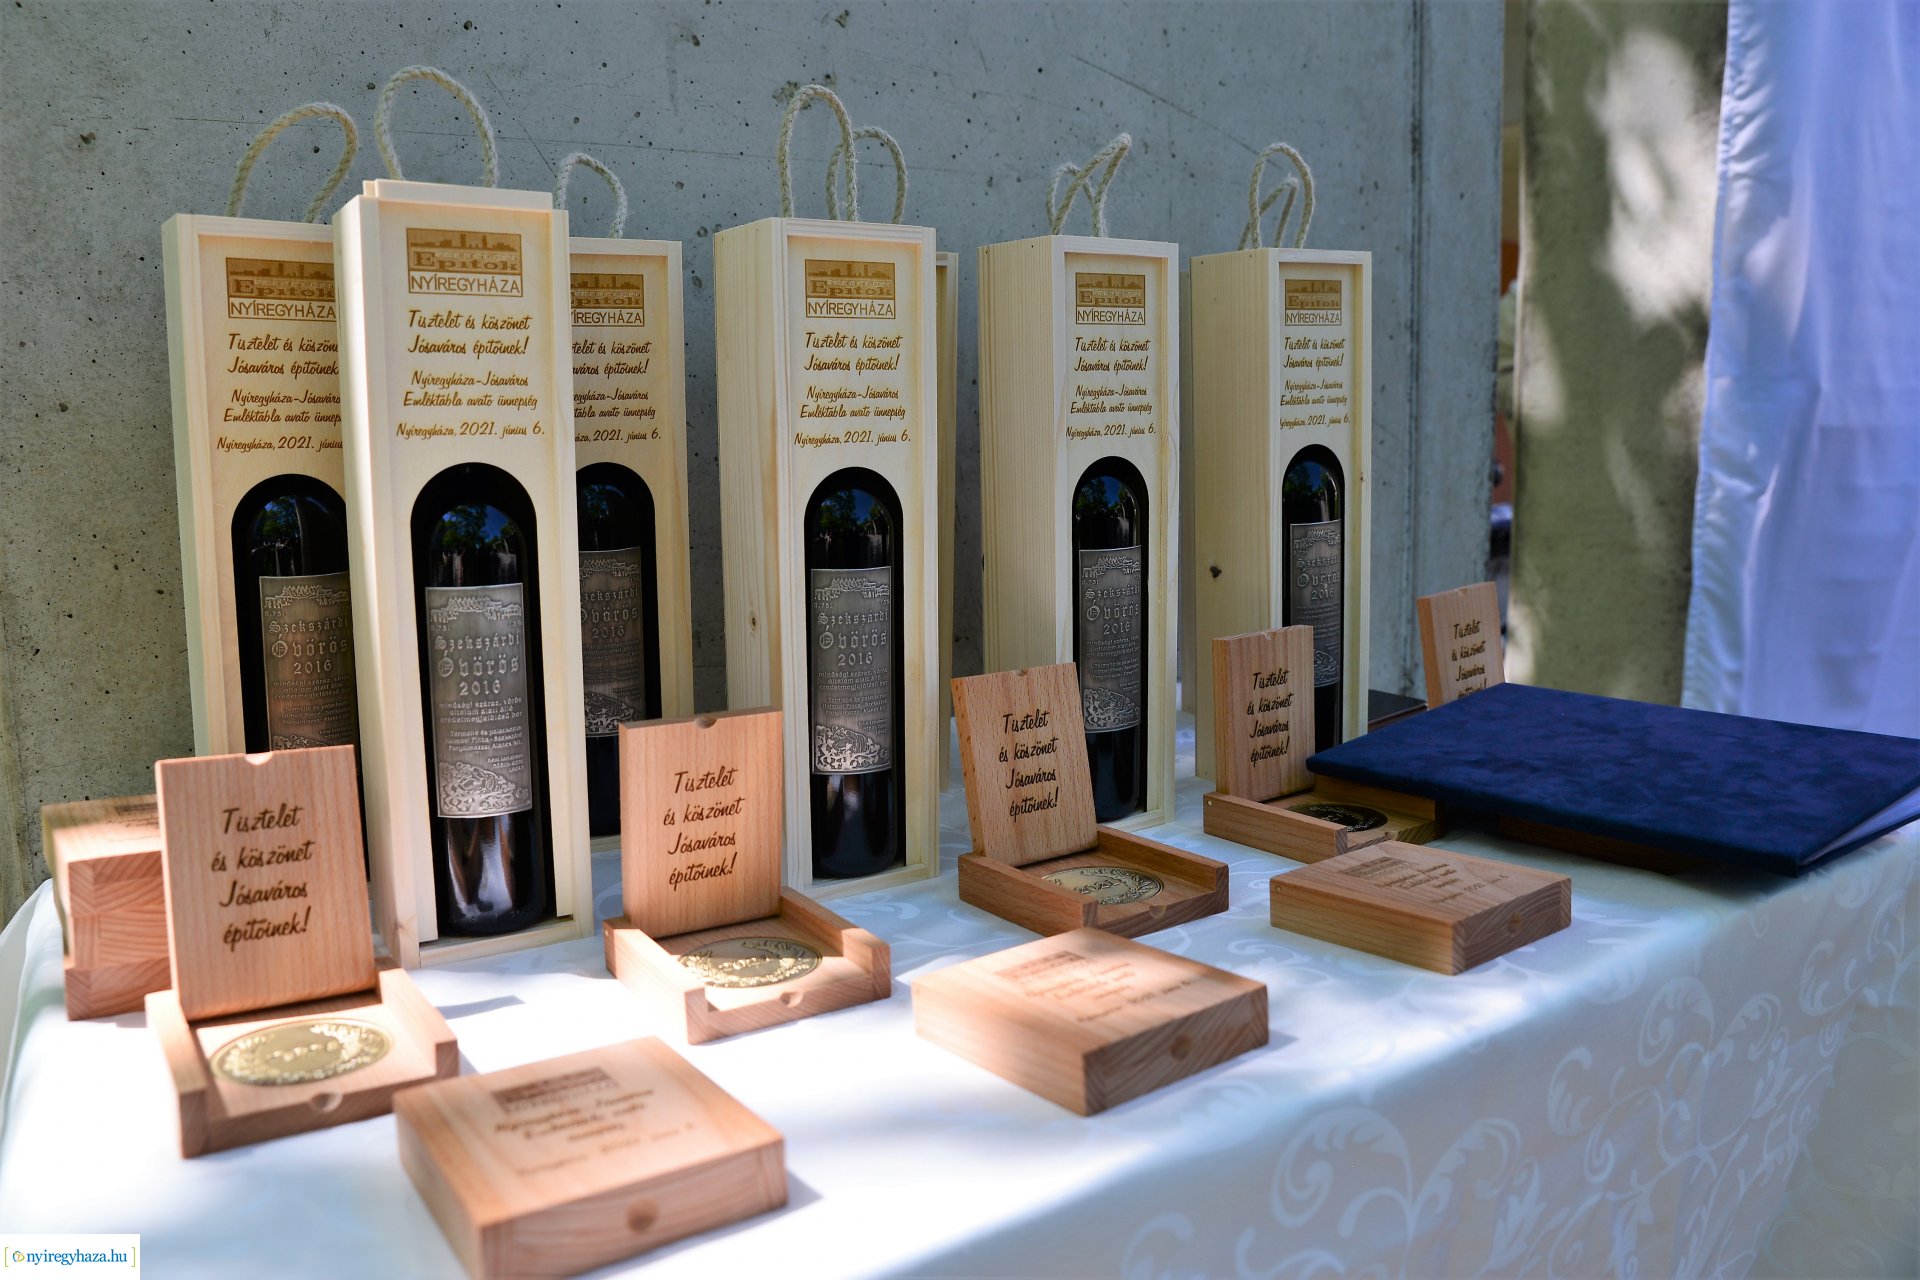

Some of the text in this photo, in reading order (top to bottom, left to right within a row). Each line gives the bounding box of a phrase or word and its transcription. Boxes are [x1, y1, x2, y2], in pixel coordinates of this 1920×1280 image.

[411, 274, 521, 294] NYÍREGYHÁZA
[231, 300, 336, 319] NYÍREGYHÁZA
[571, 309, 643, 324] ÍREGYHÁZA
[808, 300, 894, 317] NYÍREGYHÁZA
[1077, 308, 1144, 322] NYÍREGYHÁZA
[1286, 311, 1340, 323] NYÍREGYHÁZA
[408, 309, 533, 330] Tisztelet és köszönet
[228, 333, 280, 350] Tisztelet
[283, 337, 293, 352] és
[407, 334, 466, 354] Jósaváros
[597, 342, 607, 354] és
[611, 341, 653, 354] köszönet
[805, 332, 903, 349] Tisztelet és köszönet
[1075, 337, 1151, 352] Tisztelet és köszönet
[1284, 337, 1310, 350] Tisztelet
[227, 356, 339, 379] Jósaváros építőinek
[804, 354, 851, 371] Jósaváros
[1074, 356, 1110, 372] Jósaváros
[231, 389, 341, 407] Nyíregyháza-Jósaváro
[403, 391, 538, 411] Emléktábla avató ünnepség
[224, 408, 281, 422] Emléktábla
[284, 410, 311, 423] avató
[574, 405, 596, 418] tábla
[800, 404, 846, 418] Emléktábla
[396, 421, 545, 440] Nyíregyháza, 2021. június 6.
[593, 429, 624, 442] 2021.
[624, 429, 647, 443] június
[651, 428, 662, 440] 6.
[844, 430, 874, 443] 2021.
[901, 429, 911, 442] 6.
[1104, 424, 1127, 436] 2021.
[1148, 423, 1156, 434] 6.
[217, 437, 276, 453] Nyíregyháza,
[278, 436, 314, 449] 2021.
[584, 587, 638, 601] zekszárdi
[591, 625, 625, 639] 2016
[1103, 621, 1131, 635] 2016
[293, 659, 332, 675] 2016
[838, 651, 873, 666] 2016
[459, 679, 501, 696] 2016
[1253, 668, 1290, 690] Tisztelet
[1247, 692, 1294, 715] és köszönet
[1002, 708, 1050, 734] Tisztelet
[1249, 720, 1289, 738] Jósaváros
[999, 737, 1059, 762] és köszönet
[674, 765, 739, 794] Tisztelet
[1005, 767, 1056, 789] Jósaváros
[222, 803, 304, 834] Tisztelet
[663, 797, 746, 826] és köszönet
[667, 831, 736, 855] Jósaváros
[211, 840, 316, 872] és köszönet
[219, 879, 308, 907] Jósaváros
